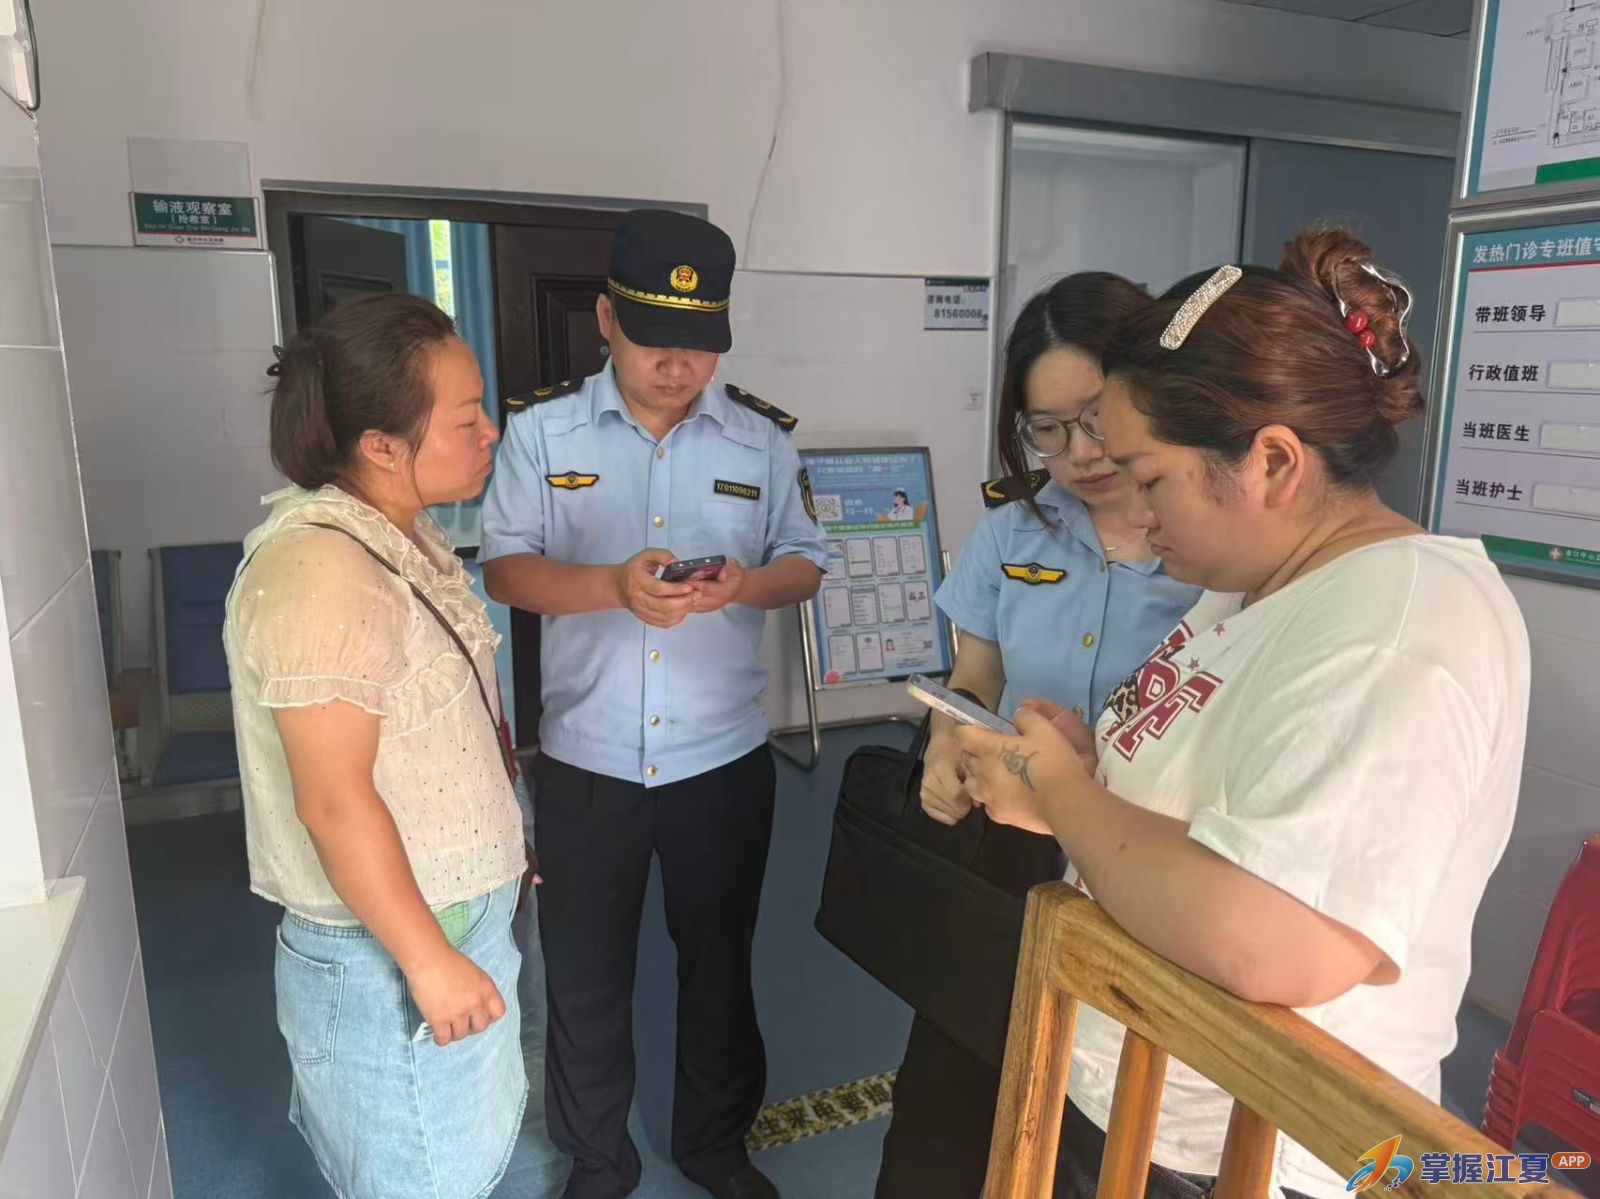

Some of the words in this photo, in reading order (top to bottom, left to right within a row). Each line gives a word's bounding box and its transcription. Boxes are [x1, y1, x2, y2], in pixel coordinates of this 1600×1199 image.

[152, 199, 232, 216] 输液观察室
[1475, 304, 1546, 324] 带班领导
[1468, 364, 1539, 382] 行政值班
[1462, 421, 1530, 442] 当班医生
[1456, 479, 1522, 501] 当班护士
